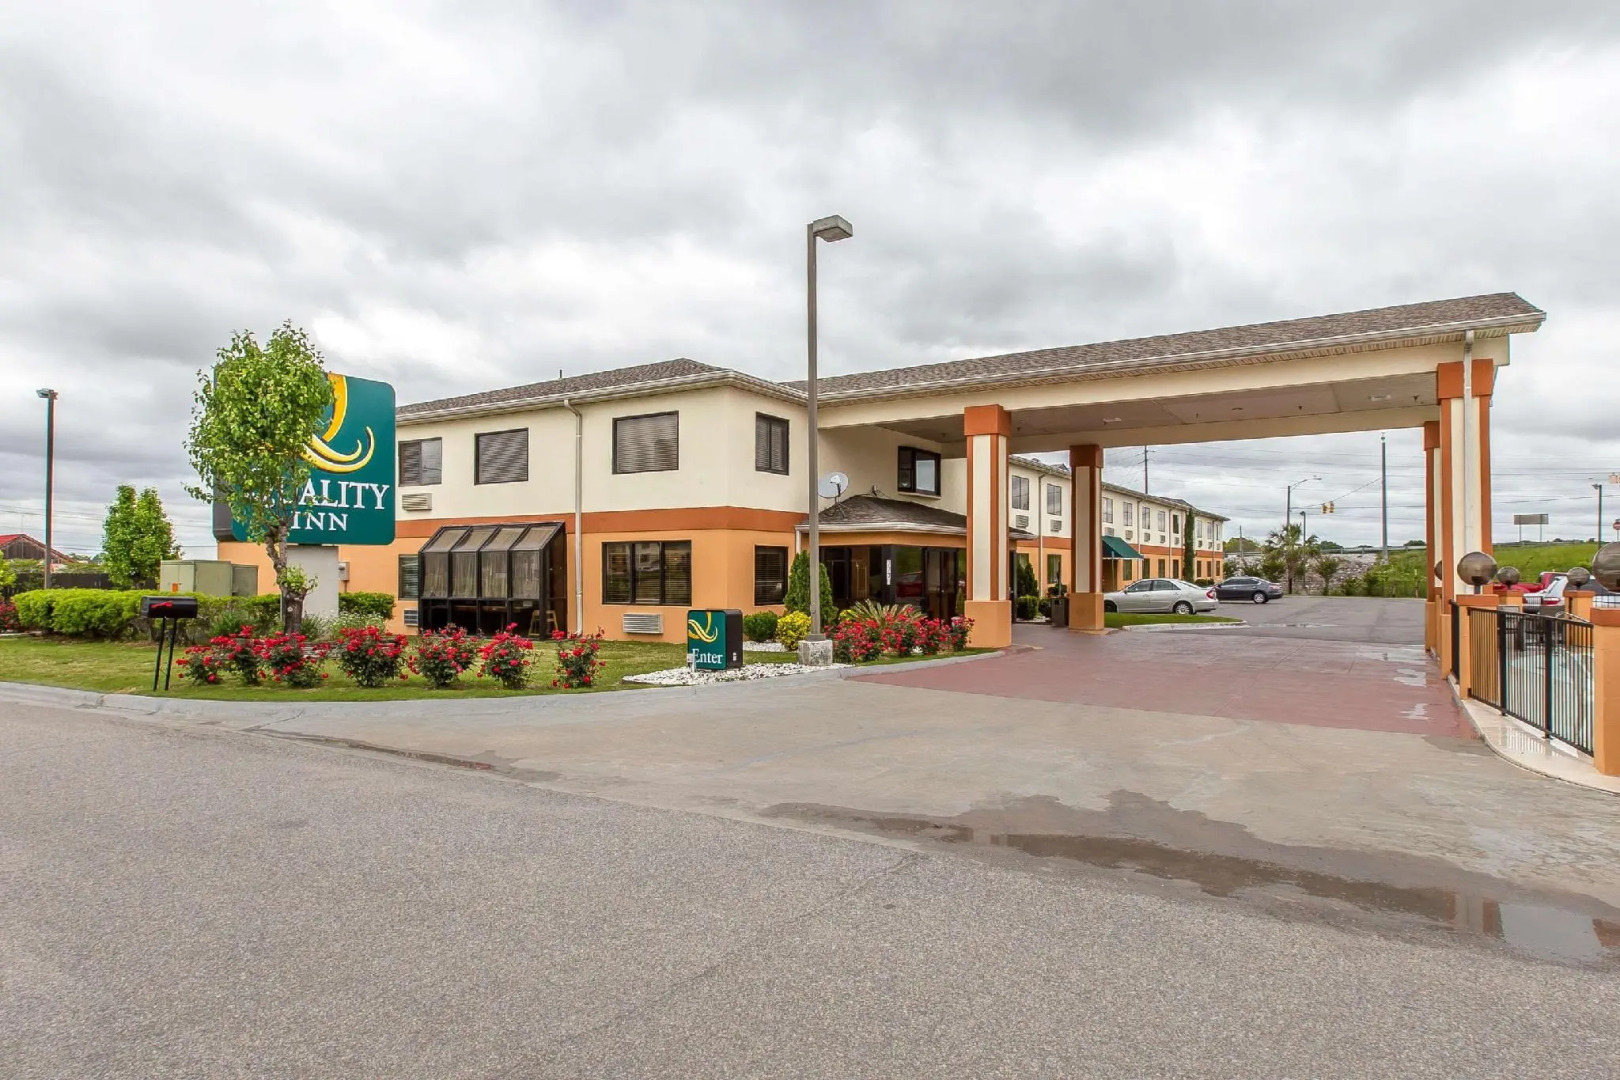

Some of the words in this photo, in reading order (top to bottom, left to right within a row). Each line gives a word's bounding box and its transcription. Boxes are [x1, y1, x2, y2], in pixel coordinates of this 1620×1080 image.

[252, 474, 390, 509] ALITY
[291, 511, 348, 531] INN
[692, 648, 723, 664] Enter
